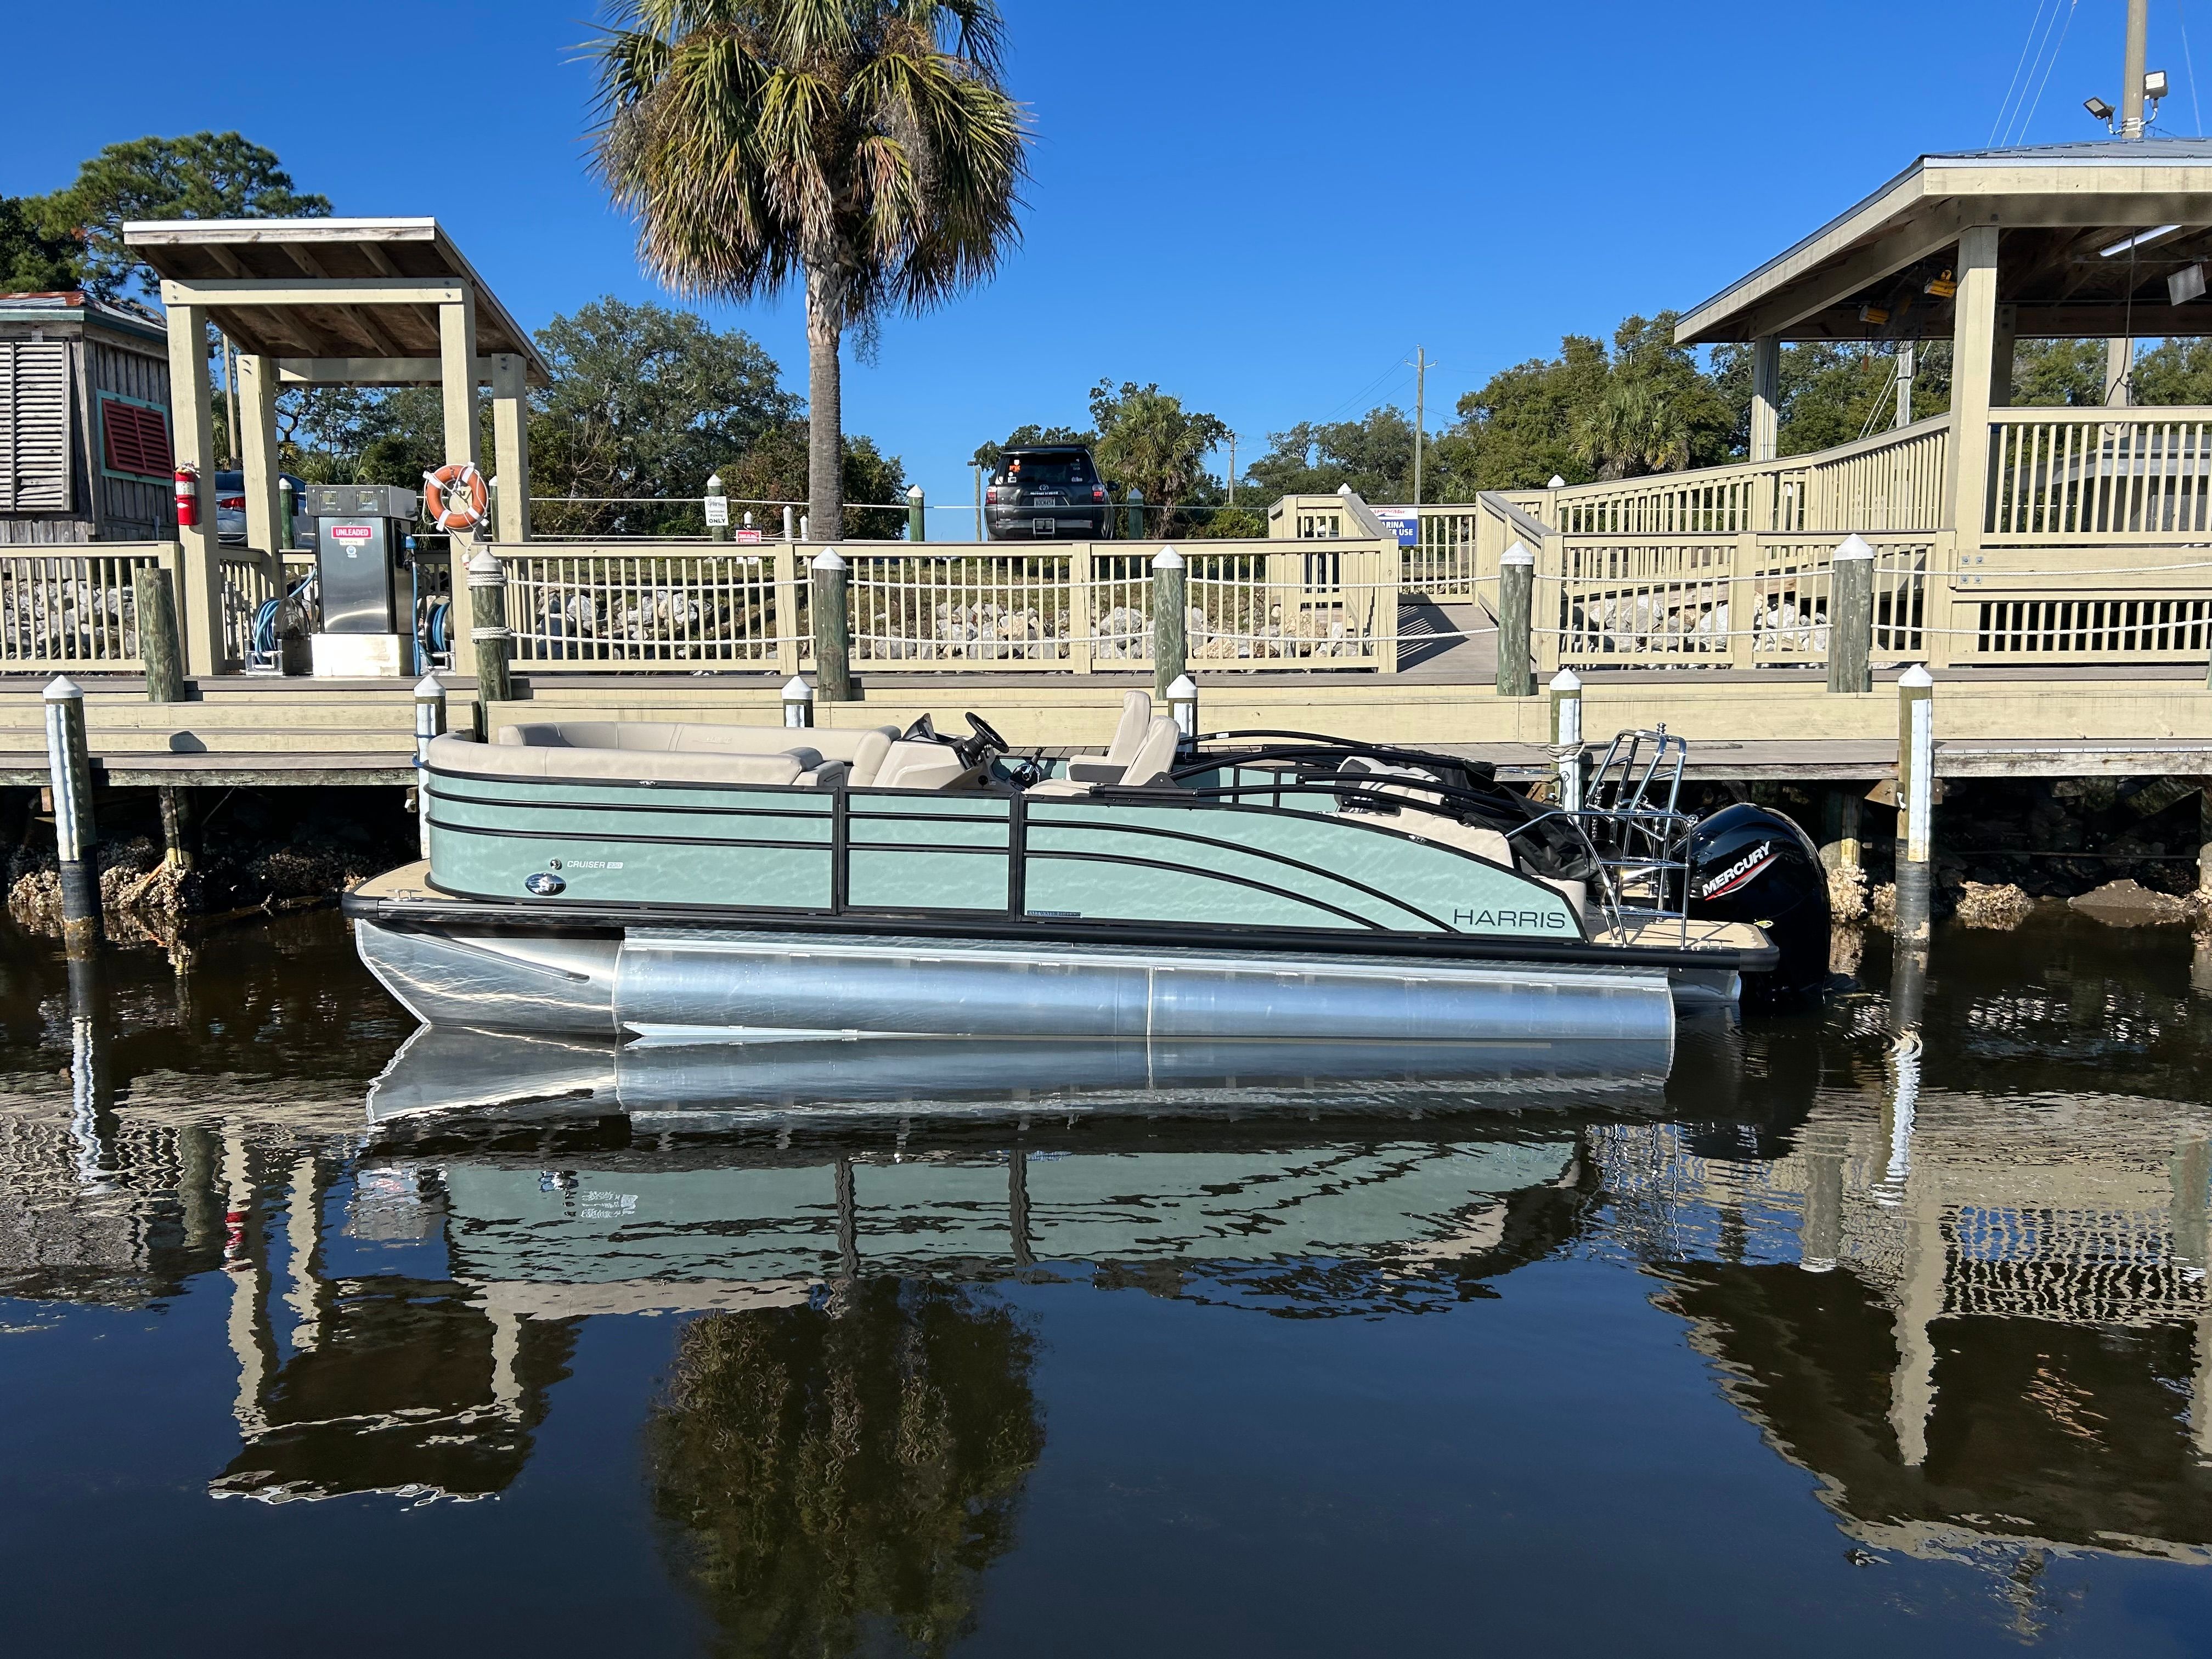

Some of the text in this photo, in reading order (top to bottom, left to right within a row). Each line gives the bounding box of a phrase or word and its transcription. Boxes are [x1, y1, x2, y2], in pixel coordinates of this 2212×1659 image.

[567, 860, 605, 868] CRUISER
[1702, 840, 1770, 896] MERCURY
[1454, 909, 1565, 928] HARRIS
